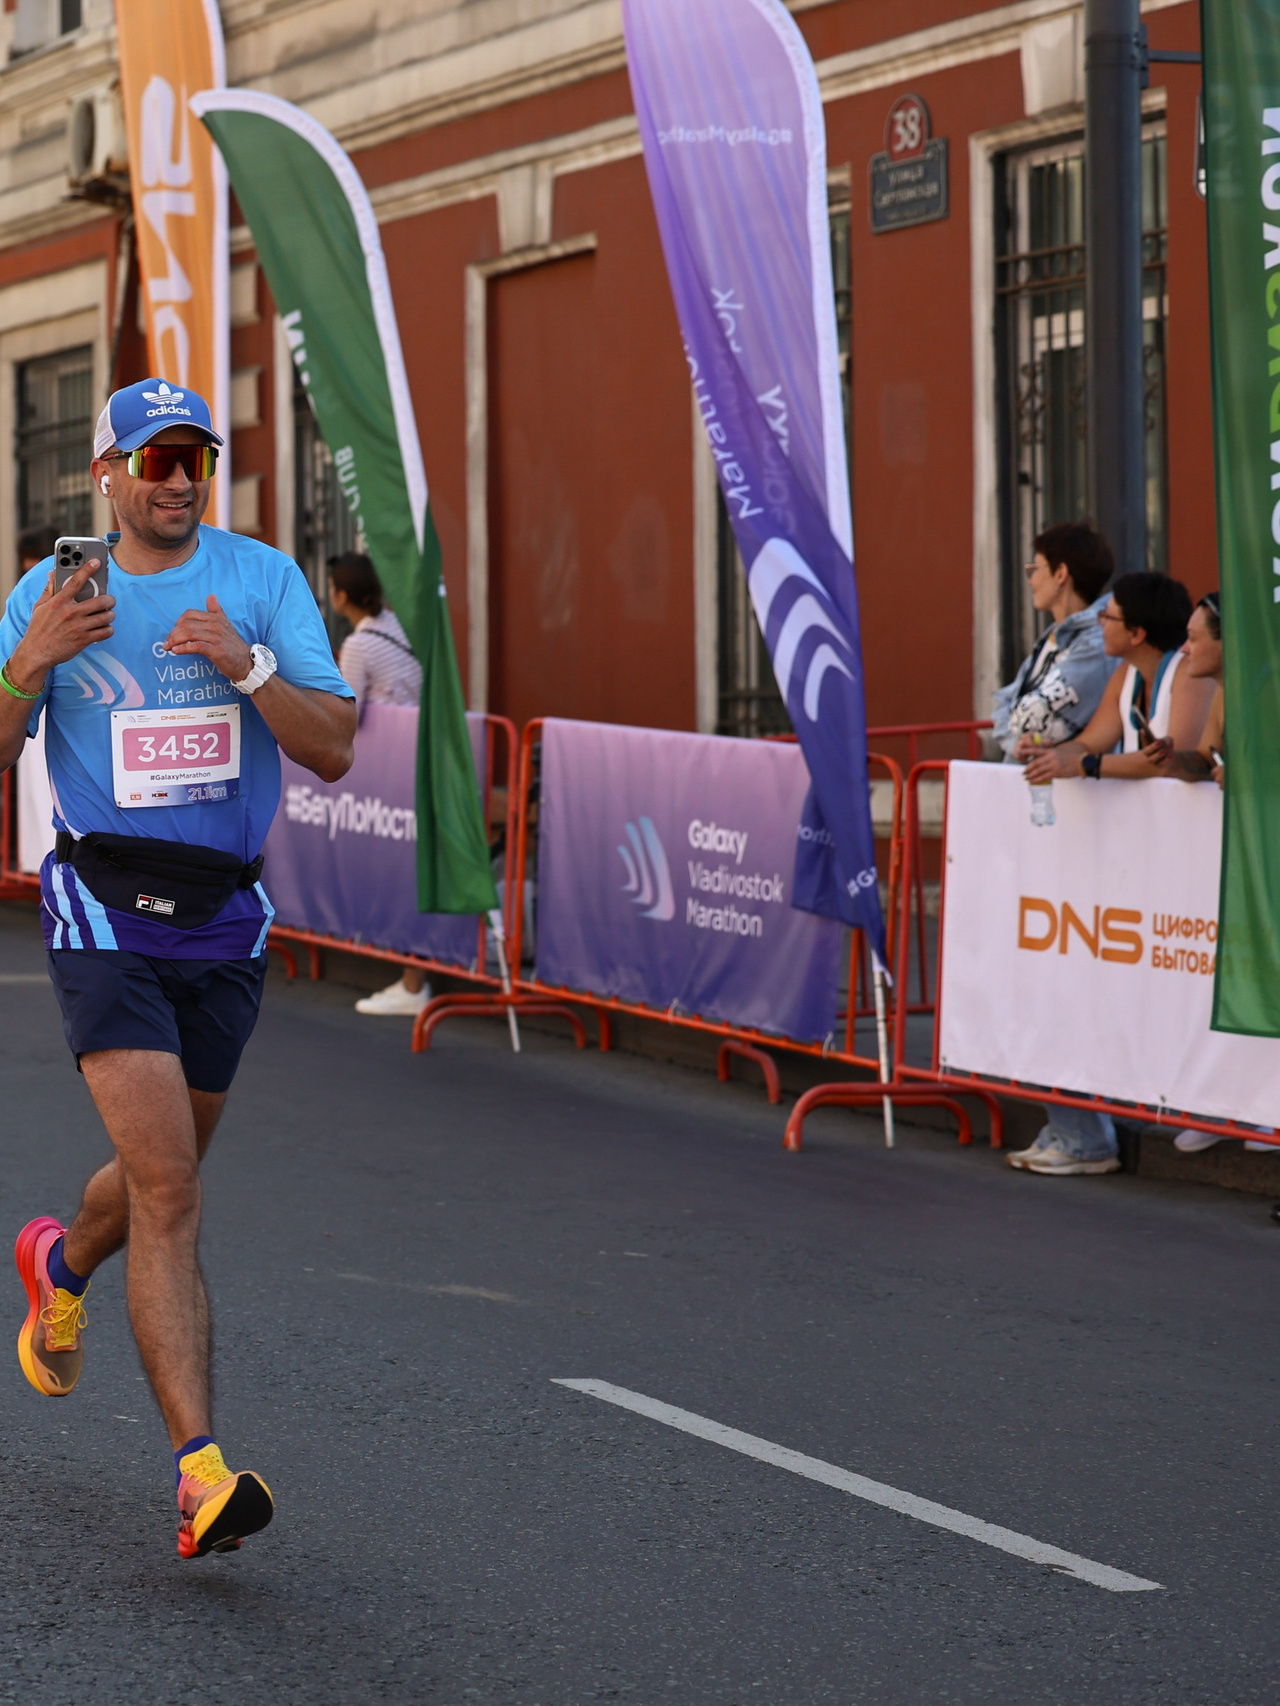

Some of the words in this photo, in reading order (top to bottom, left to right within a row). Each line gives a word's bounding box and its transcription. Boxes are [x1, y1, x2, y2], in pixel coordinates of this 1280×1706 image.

[891, 106, 922, 153] 38
[146, 405, 192, 418] adidas
[154, 660, 224, 683] Vladiv
[137, 732, 219, 762] 3452
[150, 771, 212, 781] #GalaxyMarathon
[187, 786, 228, 801] 21.1km
[687, 819, 748, 865] Galaxy
[687, 860, 784, 903] Vladivostok
[686, 897, 763, 938] Marathon
[1018, 895, 1144, 965] DNS
[1152, 912, 1219, 943] ЦИФРО
[1151, 945, 1218, 976] БЫТОВ
